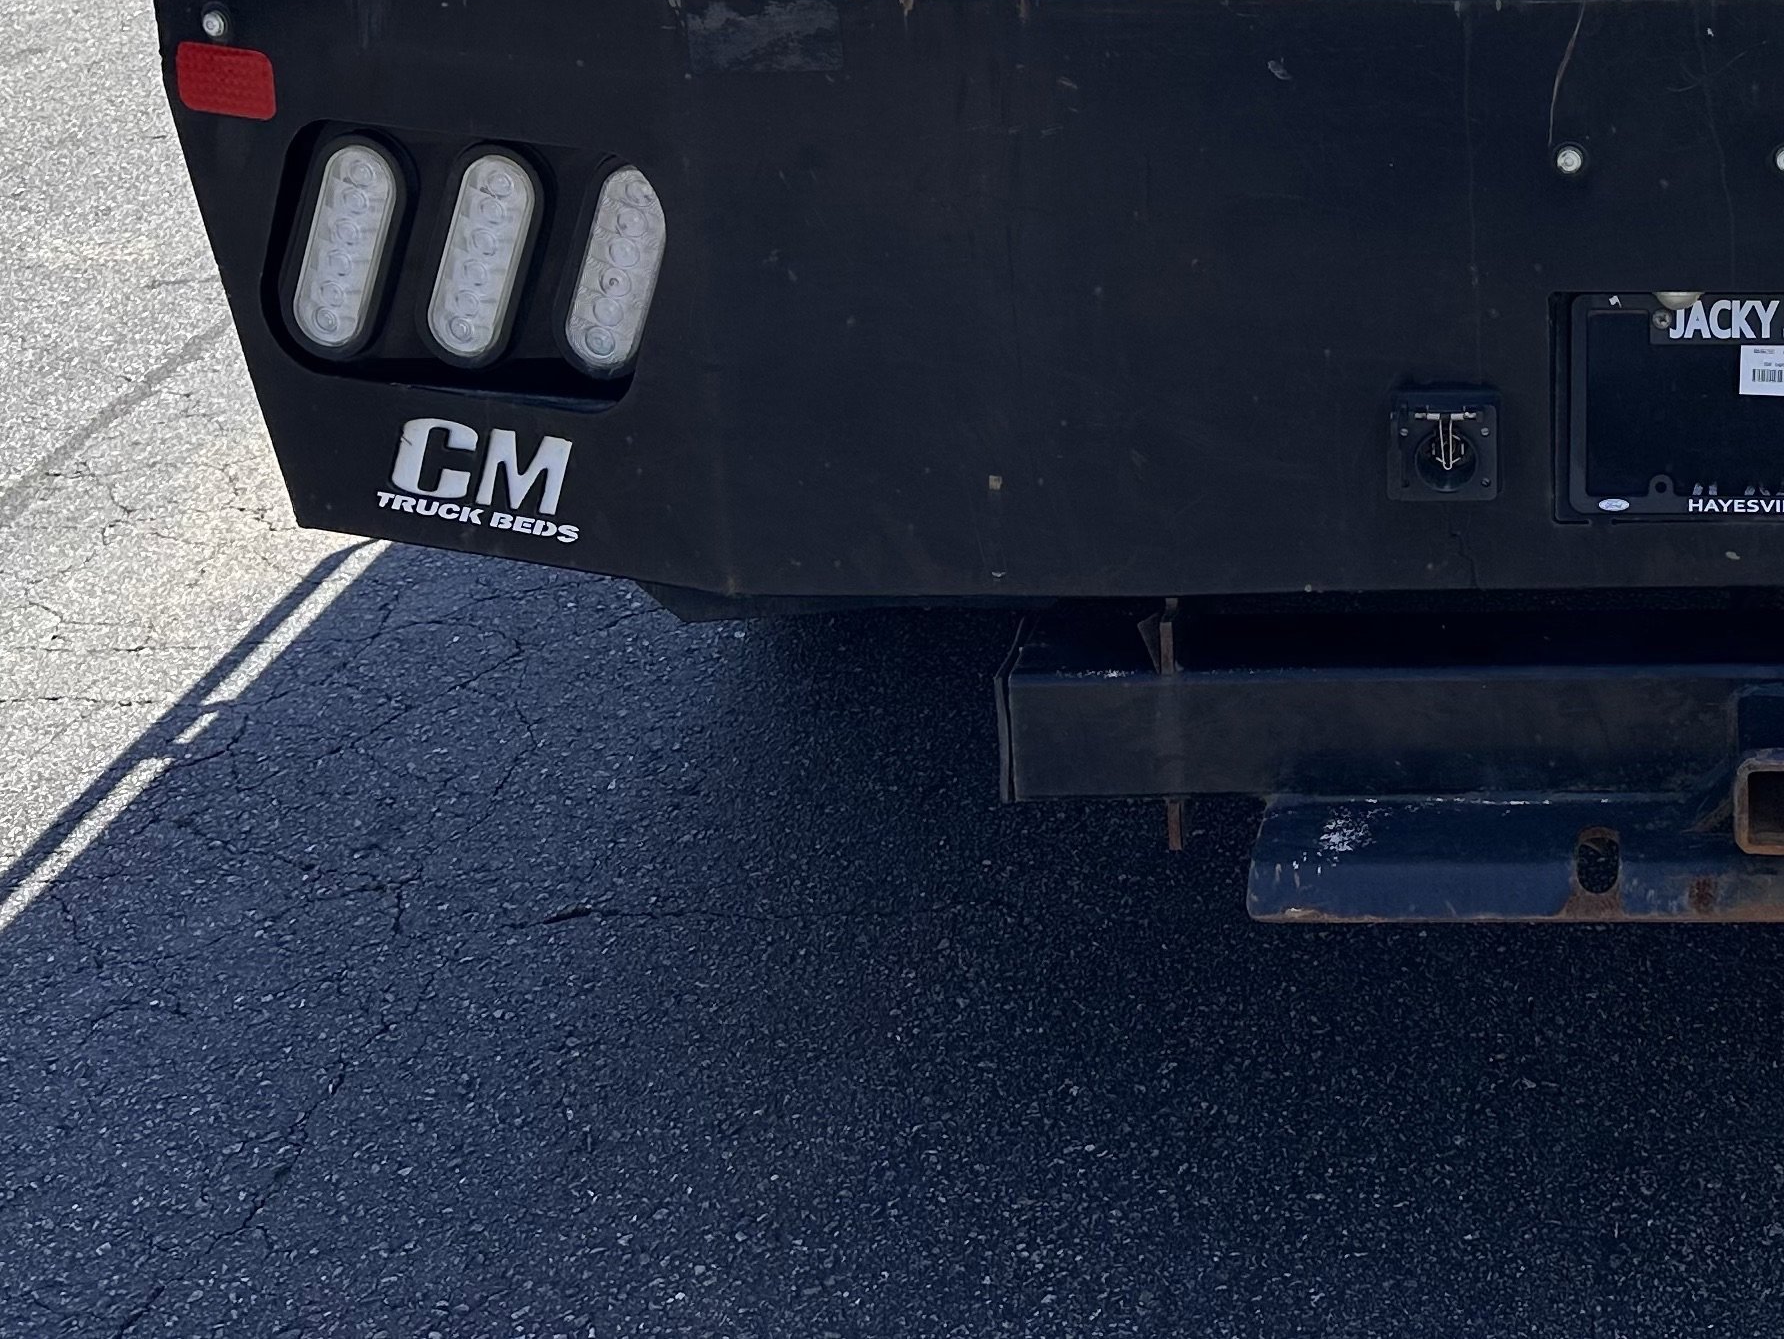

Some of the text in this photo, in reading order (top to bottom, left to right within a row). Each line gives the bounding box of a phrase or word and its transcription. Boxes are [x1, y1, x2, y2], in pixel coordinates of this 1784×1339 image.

[1669, 299, 1780, 340] JACKY
[391, 417, 574, 516] CM
[376, 491, 580, 544] TRUCK BEDS
